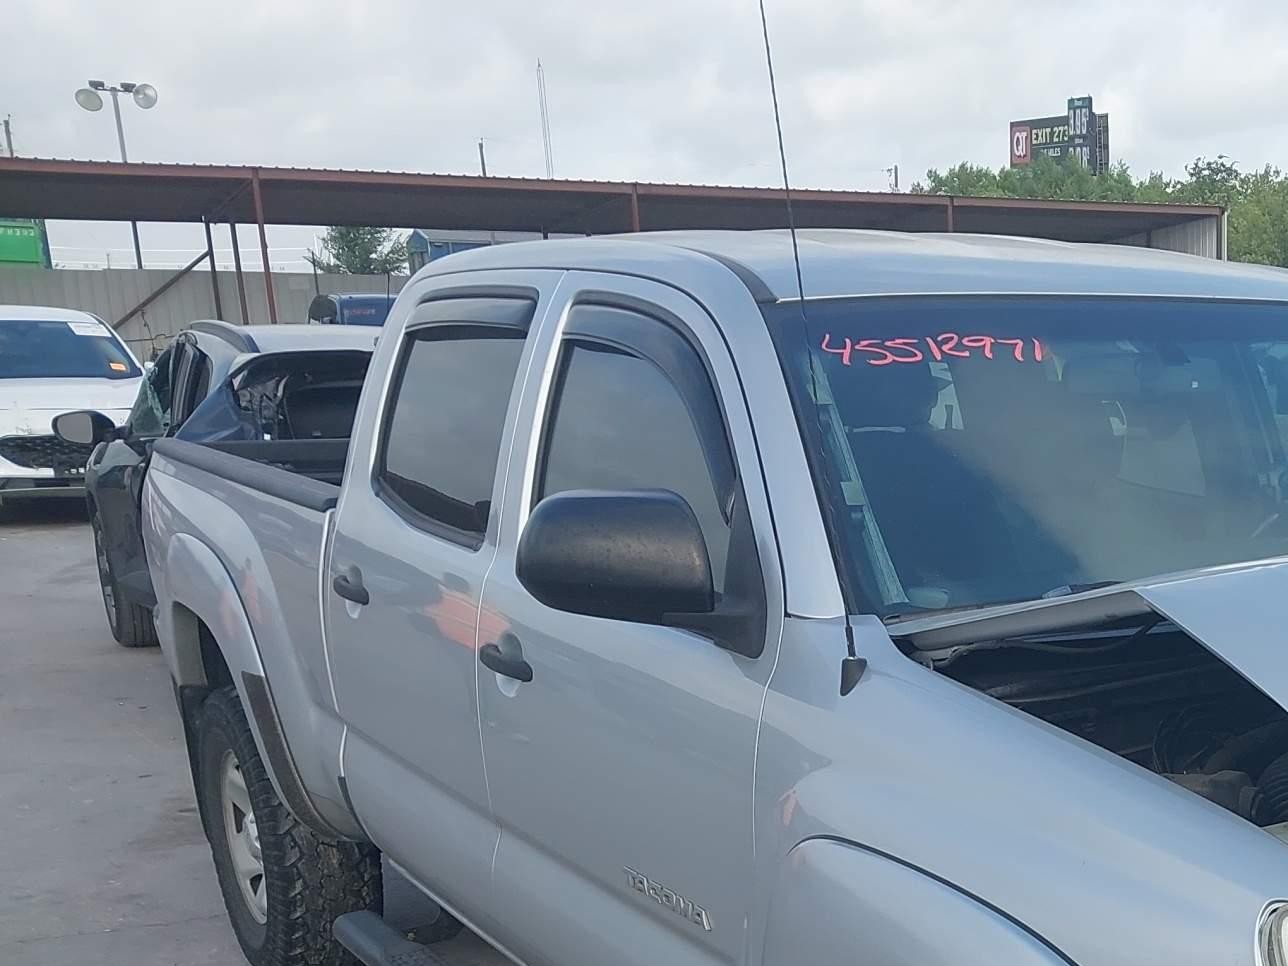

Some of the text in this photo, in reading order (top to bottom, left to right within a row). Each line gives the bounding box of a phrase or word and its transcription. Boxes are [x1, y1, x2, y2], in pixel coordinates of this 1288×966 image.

[1013, 132, 1028, 157] QT
[1032, 125, 1069, 144] EXIT 273
[821, 333, 1044, 366] 45512971
[623, 865, 712, 931] TACOMA
